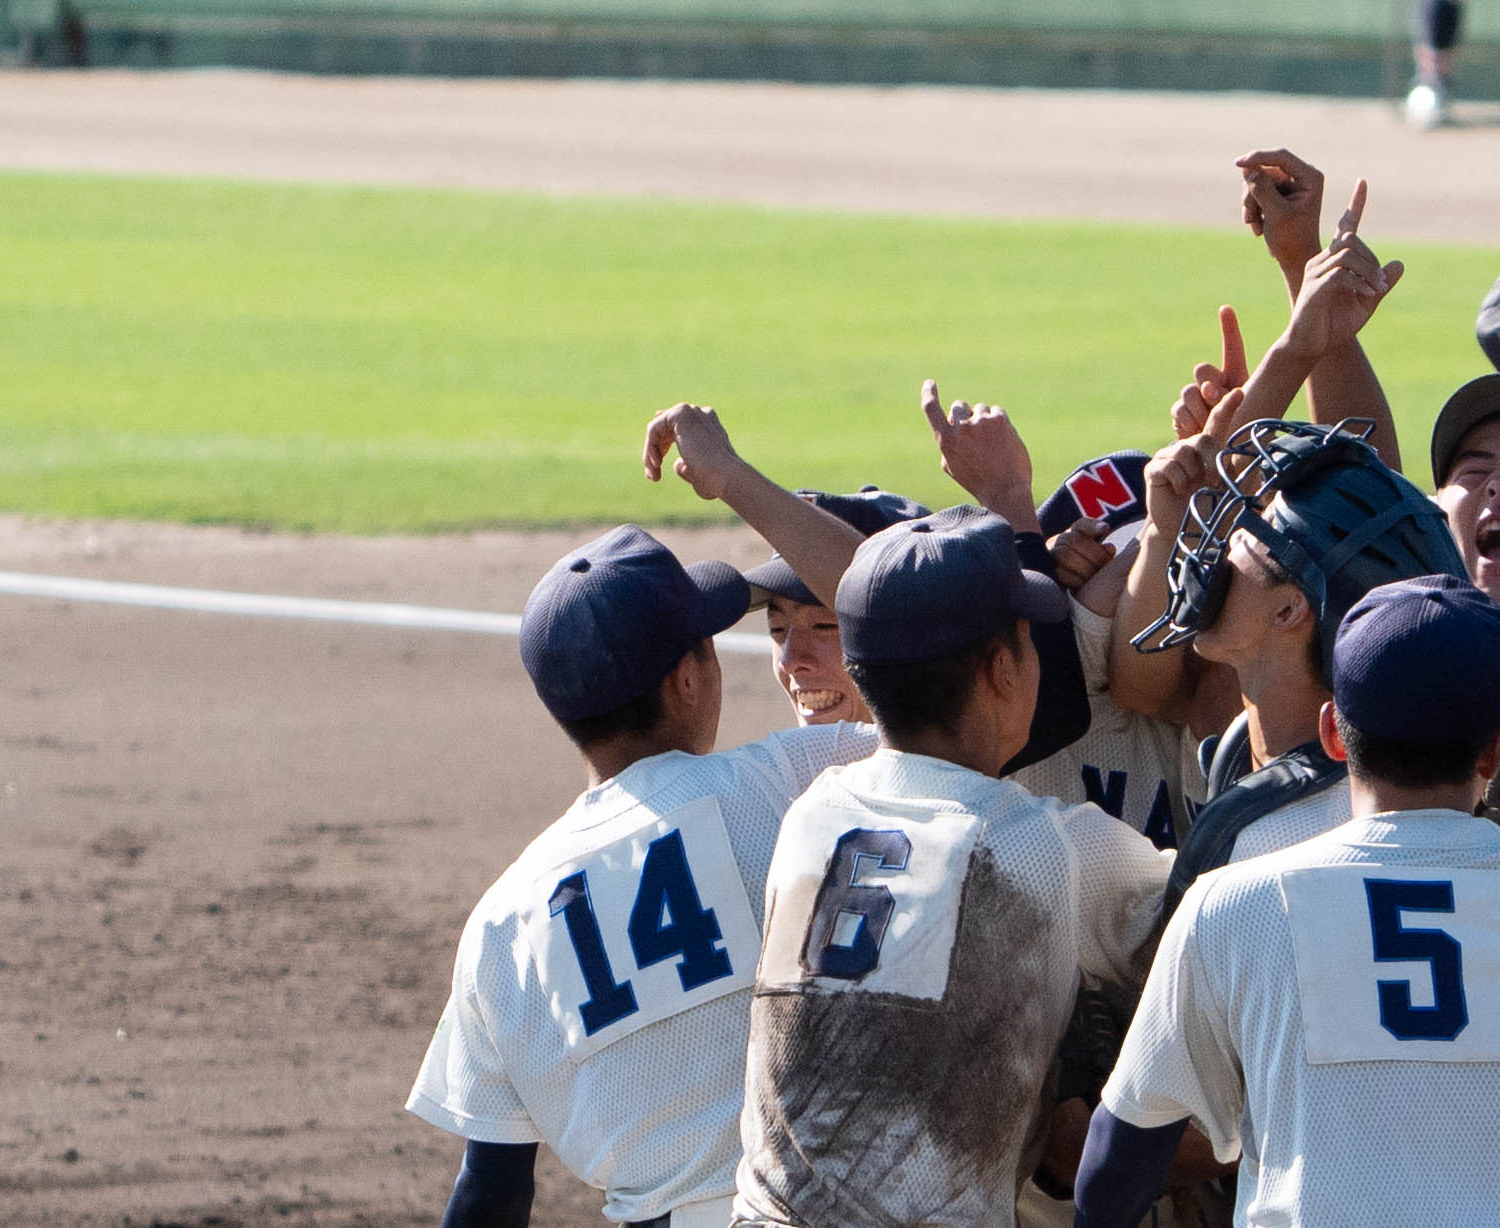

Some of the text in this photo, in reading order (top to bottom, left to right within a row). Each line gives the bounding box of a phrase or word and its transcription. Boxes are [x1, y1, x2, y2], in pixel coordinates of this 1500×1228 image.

[1065, 459, 1137, 520] N
[548, 828, 734, 1037] 14
[798, 827, 912, 981] 6
[1363, 878, 1469, 1041] 5
